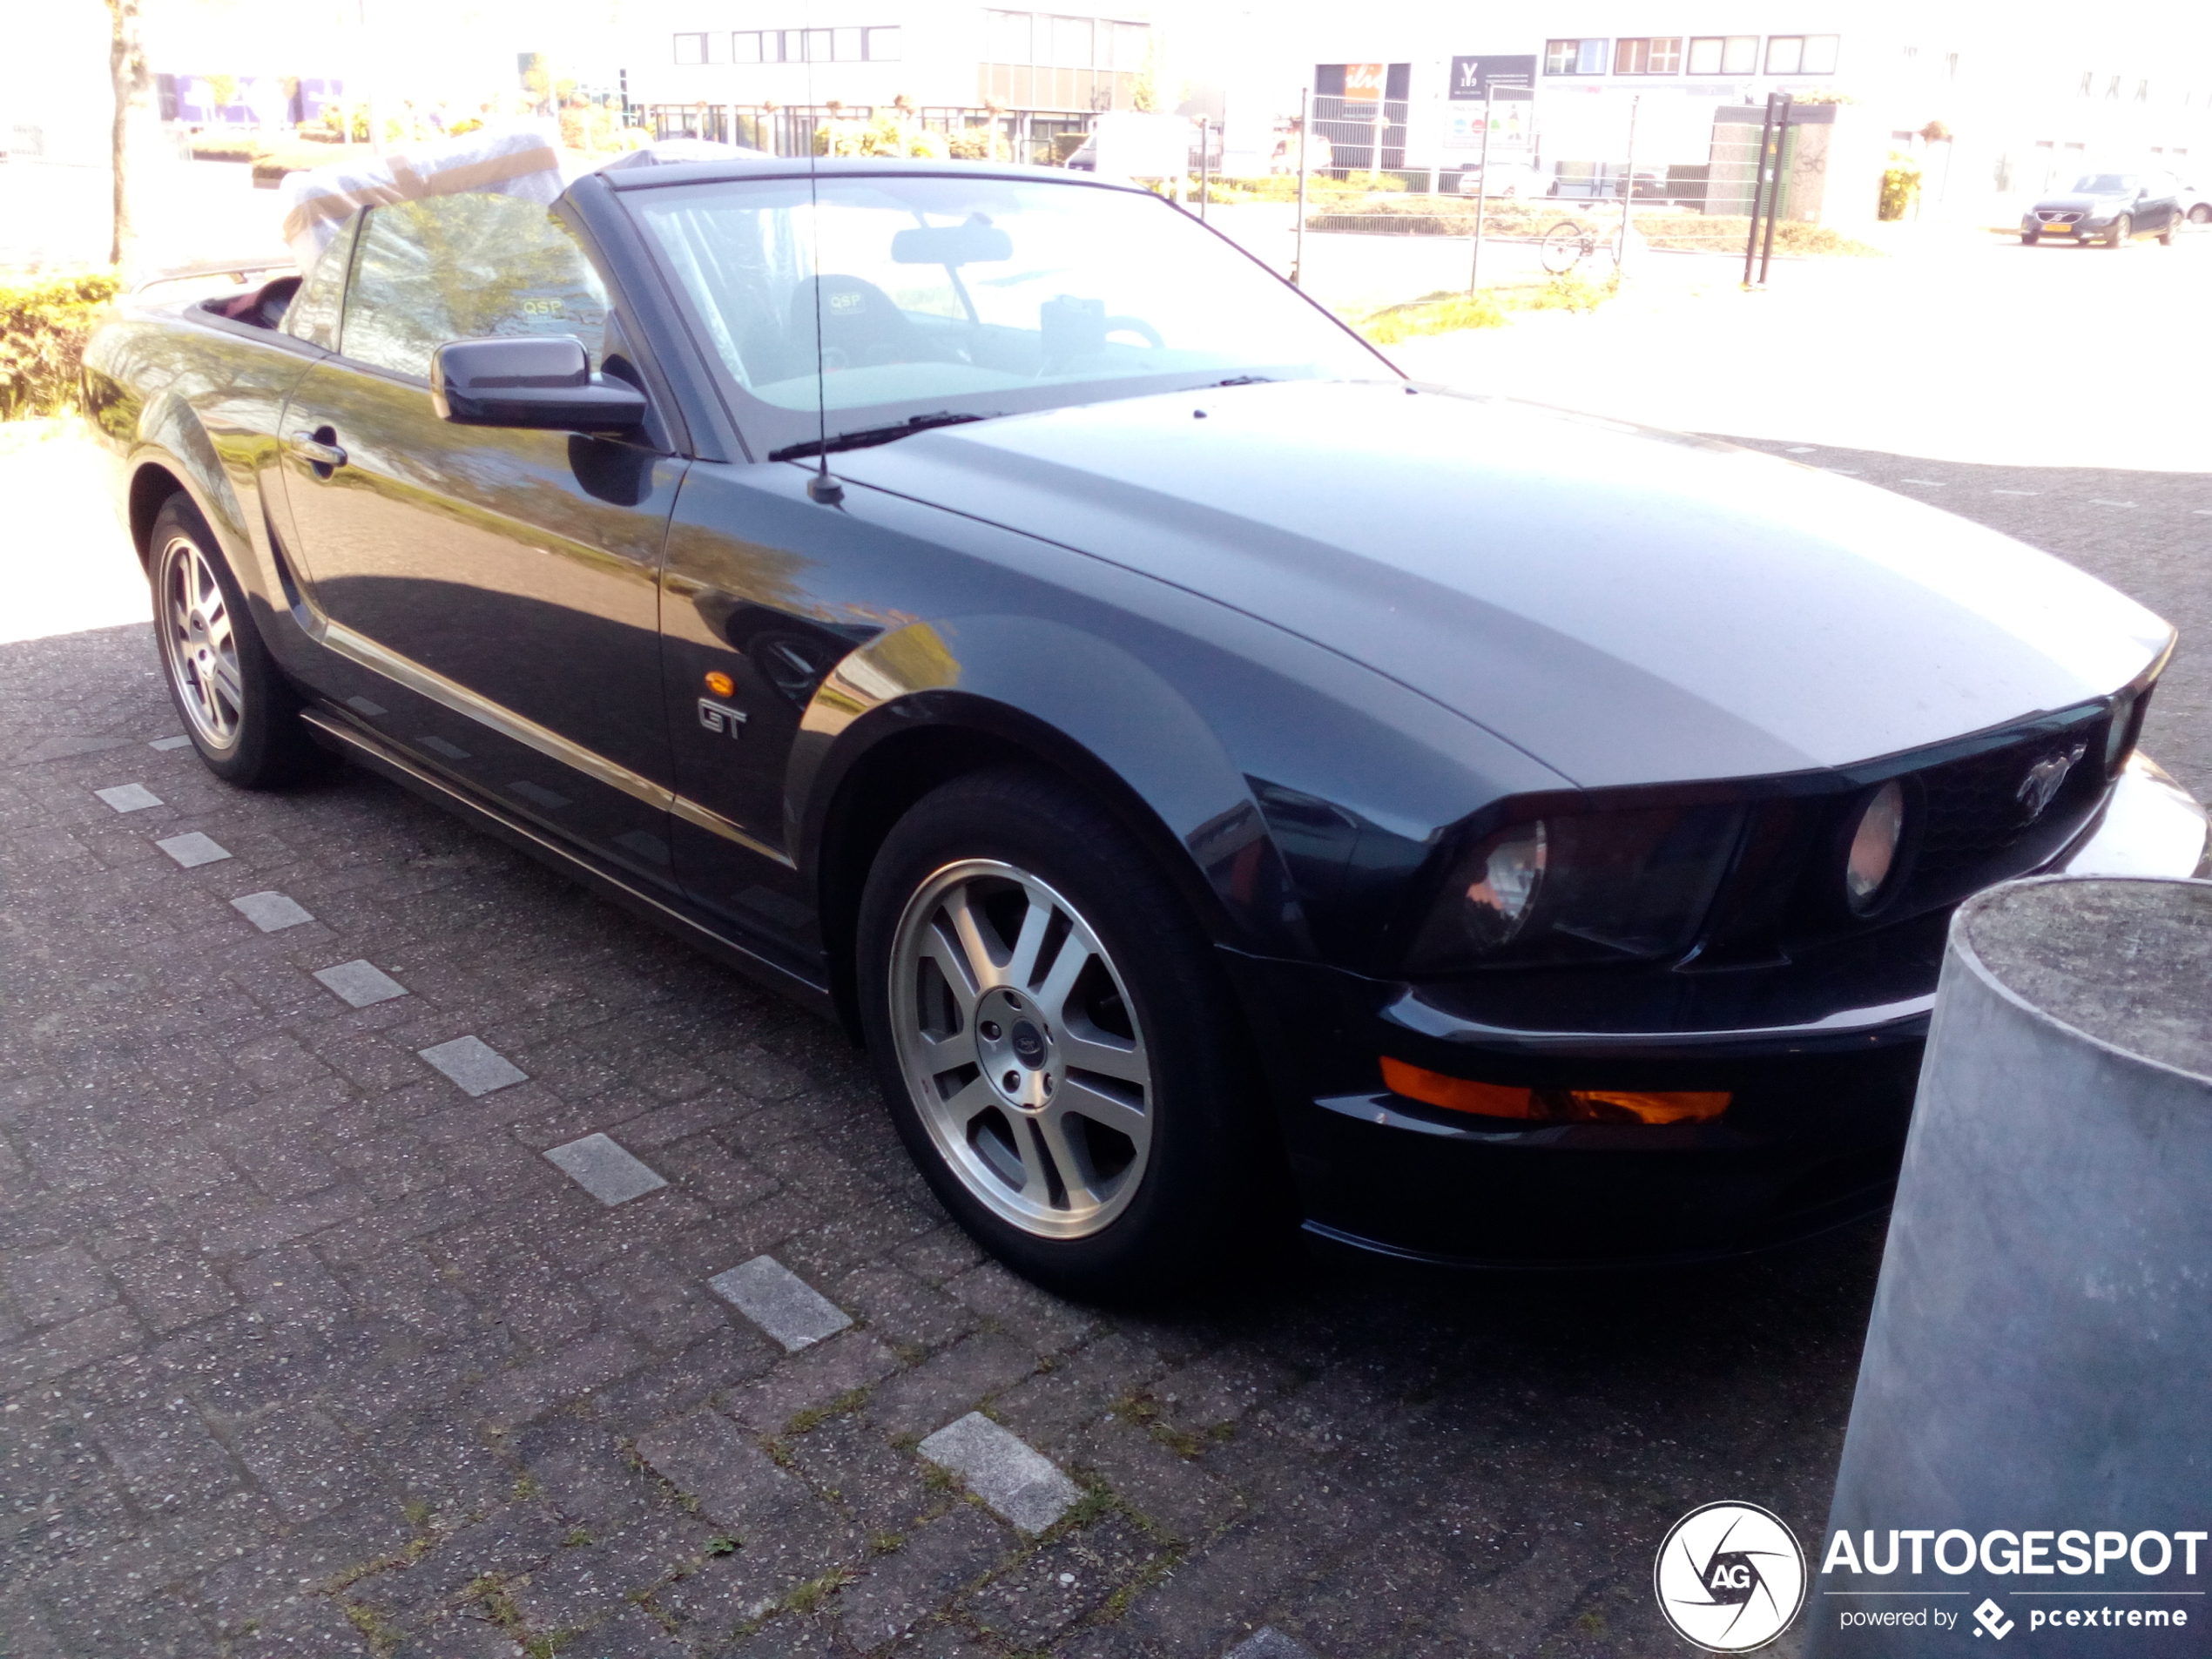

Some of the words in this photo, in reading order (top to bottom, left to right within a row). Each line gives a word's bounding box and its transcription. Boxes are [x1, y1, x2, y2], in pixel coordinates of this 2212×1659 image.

[523, 300, 563, 315] QSP
[831, 294, 860, 308] QSP
[698, 698, 747, 739] GT
